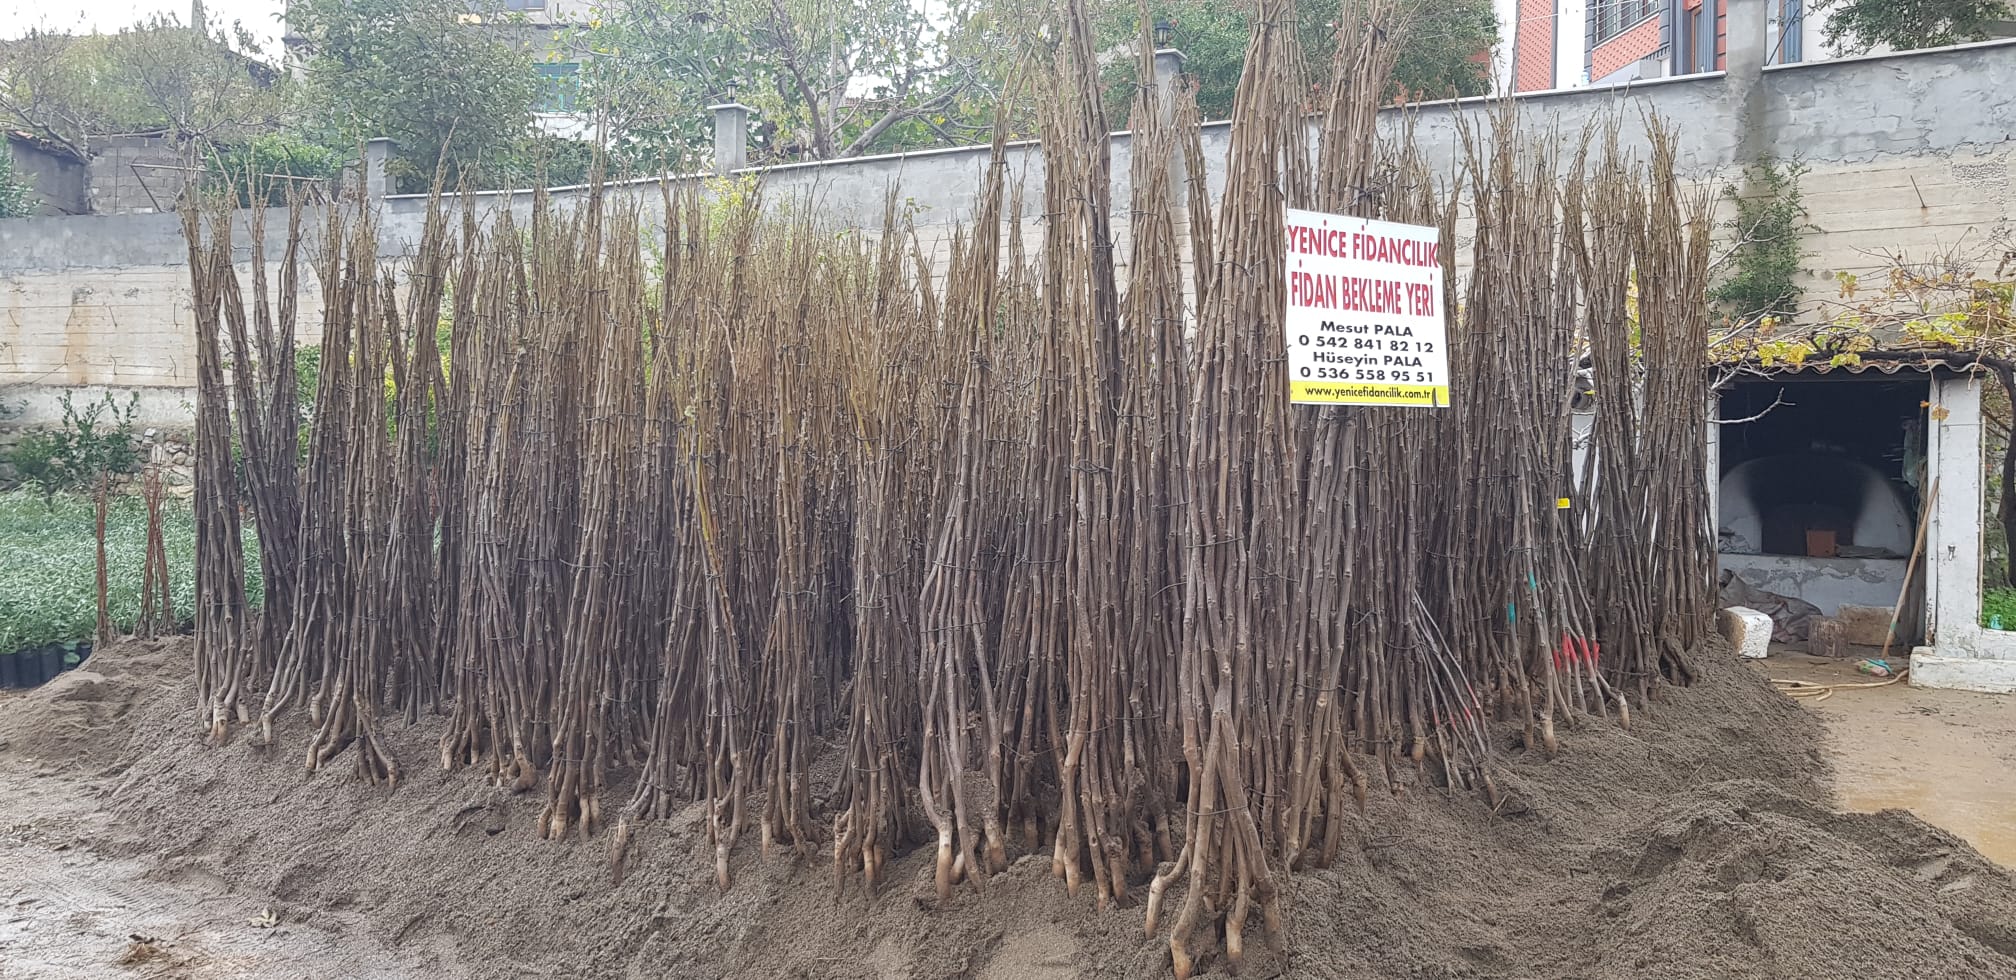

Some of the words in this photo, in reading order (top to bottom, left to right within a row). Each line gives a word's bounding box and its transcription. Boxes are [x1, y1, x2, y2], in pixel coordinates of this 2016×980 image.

[1288, 220, 1347, 258] YENİCE
[1353, 225, 1439, 268] FİDANCILIK
[1291, 259, 1336, 309] FİDAN
[1343, 276, 1401, 314] BEKLEME
[1405, 273, 1434, 317] YERİ
[1320, 321, 1369, 334] Mesut
[1375, 325, 1413, 337] PALA
[1299, 335, 1309, 346] 0
[1316, 336, 1348, 348] 542
[1354, 338, 1382, 350] 841
[1390, 341, 1408, 351] 82
[1416, 342, 1433, 353] 12
[1313, 352, 1377, 367] Hüseyin
[1384, 356, 1422, 367] PALA
[1300, 367, 1311, 377] 0
[1317, 368, 1349, 379] 536
[1356, 369, 1385, 380] 558
[1391, 371, 1410, 381] 95
[1416, 372, 1433, 382] 51
[1305, 386, 1430, 399] www.yenicefidancilik.com.tr
